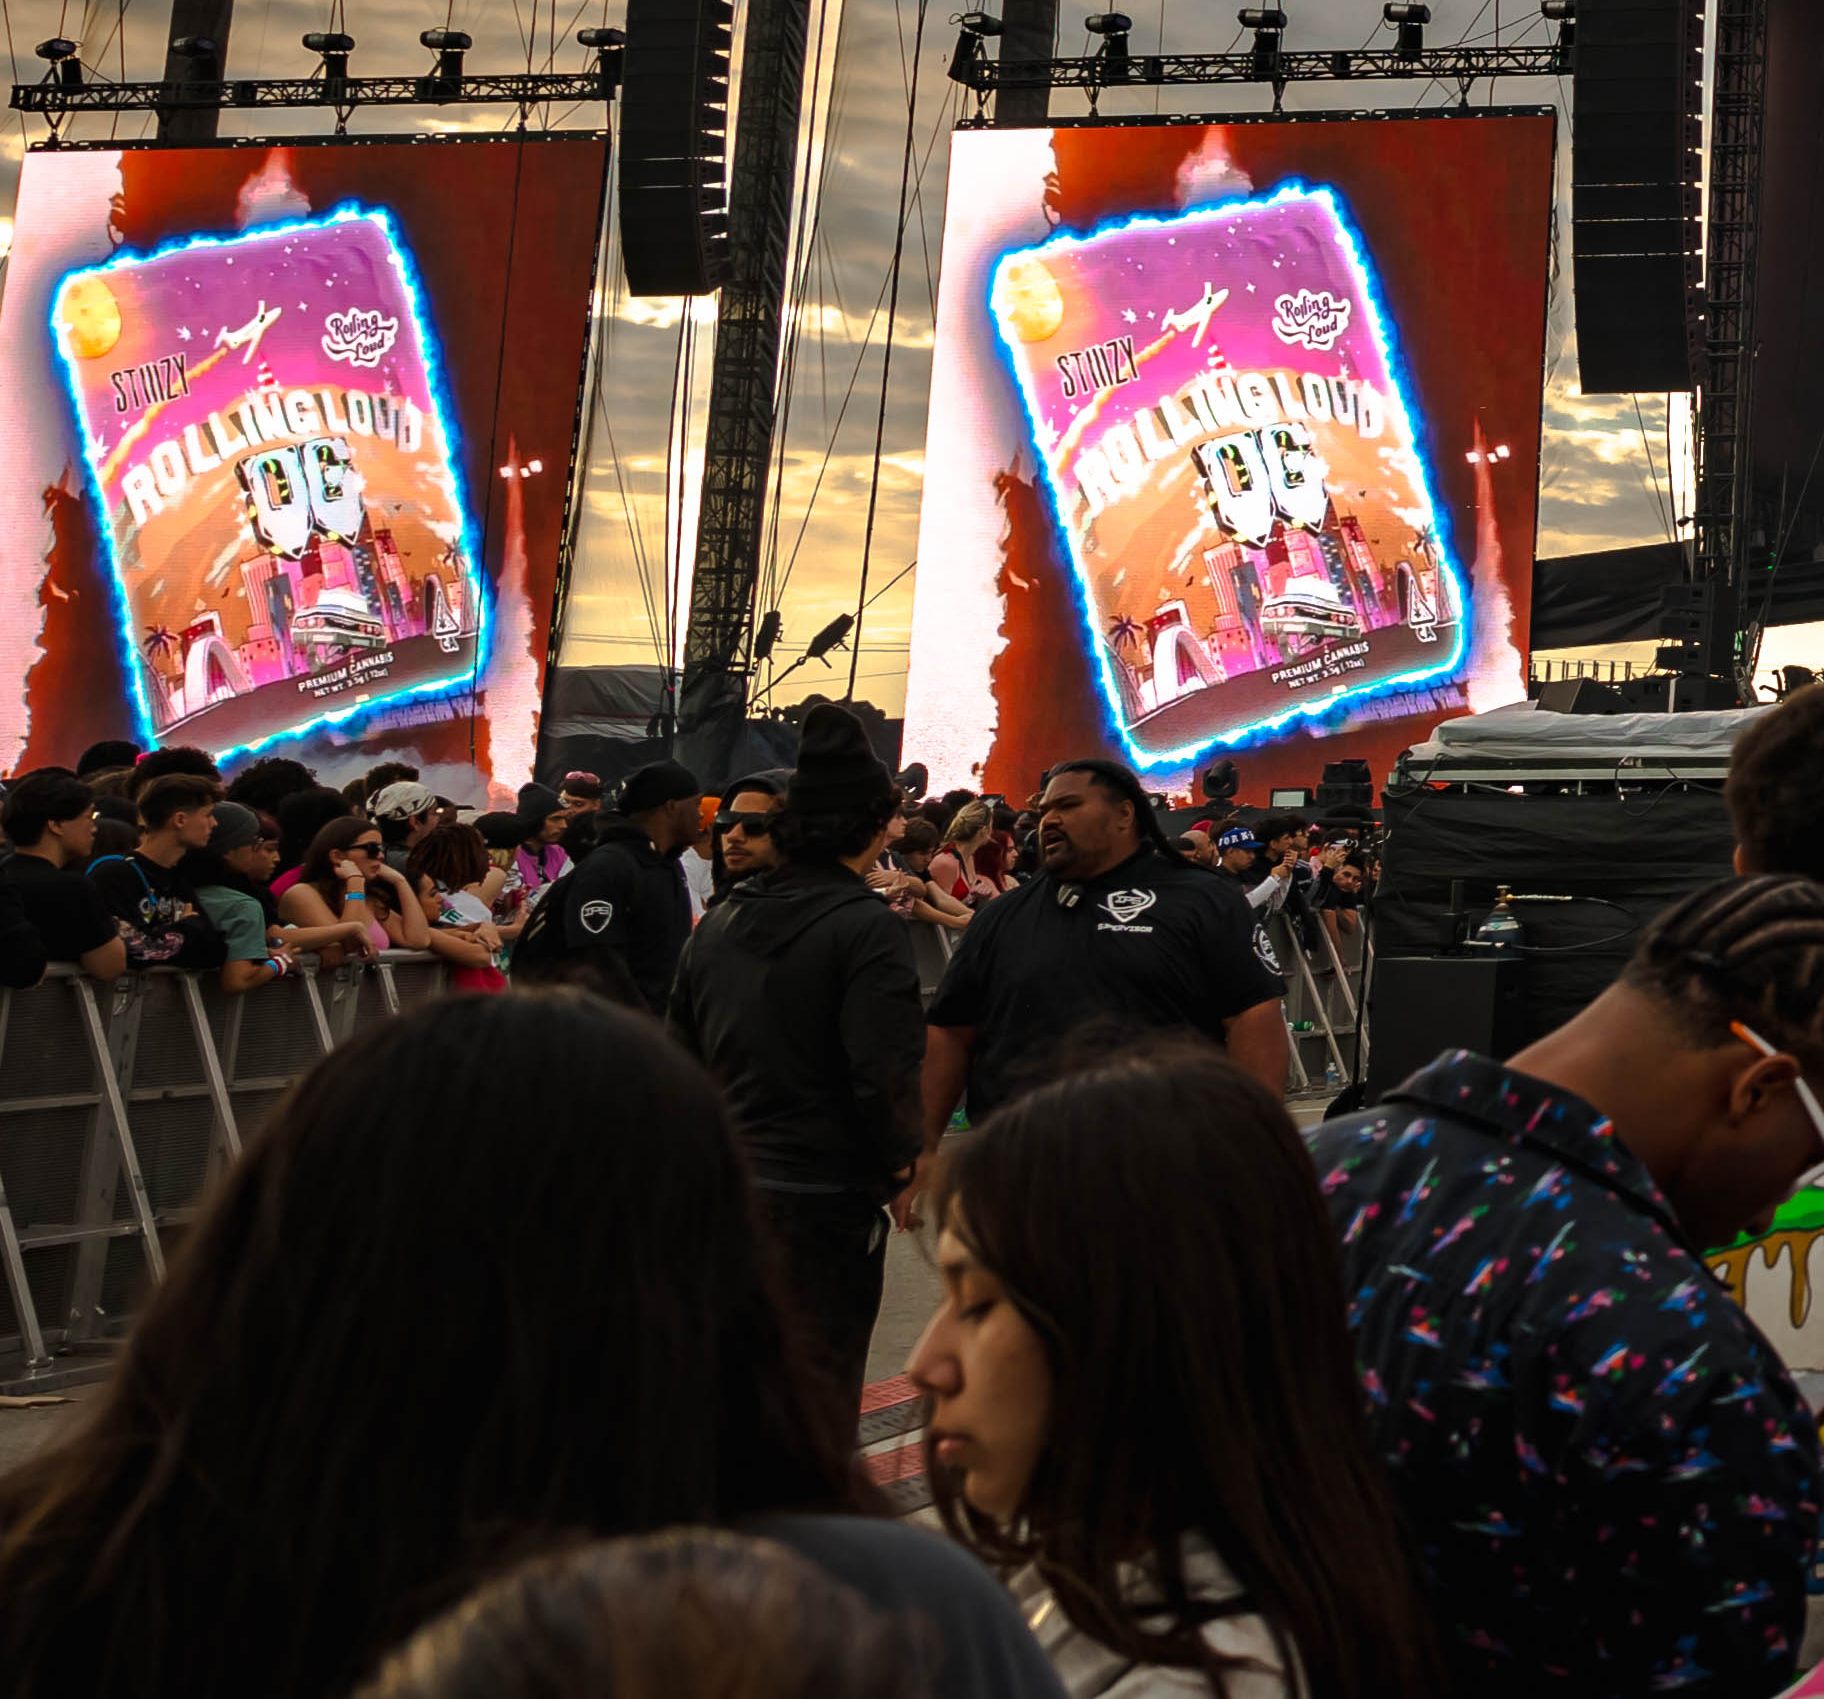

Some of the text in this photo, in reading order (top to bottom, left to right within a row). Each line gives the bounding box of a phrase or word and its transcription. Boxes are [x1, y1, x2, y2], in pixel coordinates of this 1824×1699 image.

[330, 312, 395, 344] Rolling
[1275, 317, 1338, 345] Loud
[1280, 295, 1347, 327] Rolling
[325, 334, 385, 362] Loud
[1057, 337, 1139, 397] STIIIZY
[110, 354, 189, 413] STIIIZY
[120, 388, 322, 526] ROLLING
[1073, 371, 1384, 514] ROLLING LOUD
[298, 651, 394, 692] PREMIUM CANNABIS
[1271, 641, 1370, 684] PREMIUM CANNABIS
[1288, 677, 1305, 689] NET
